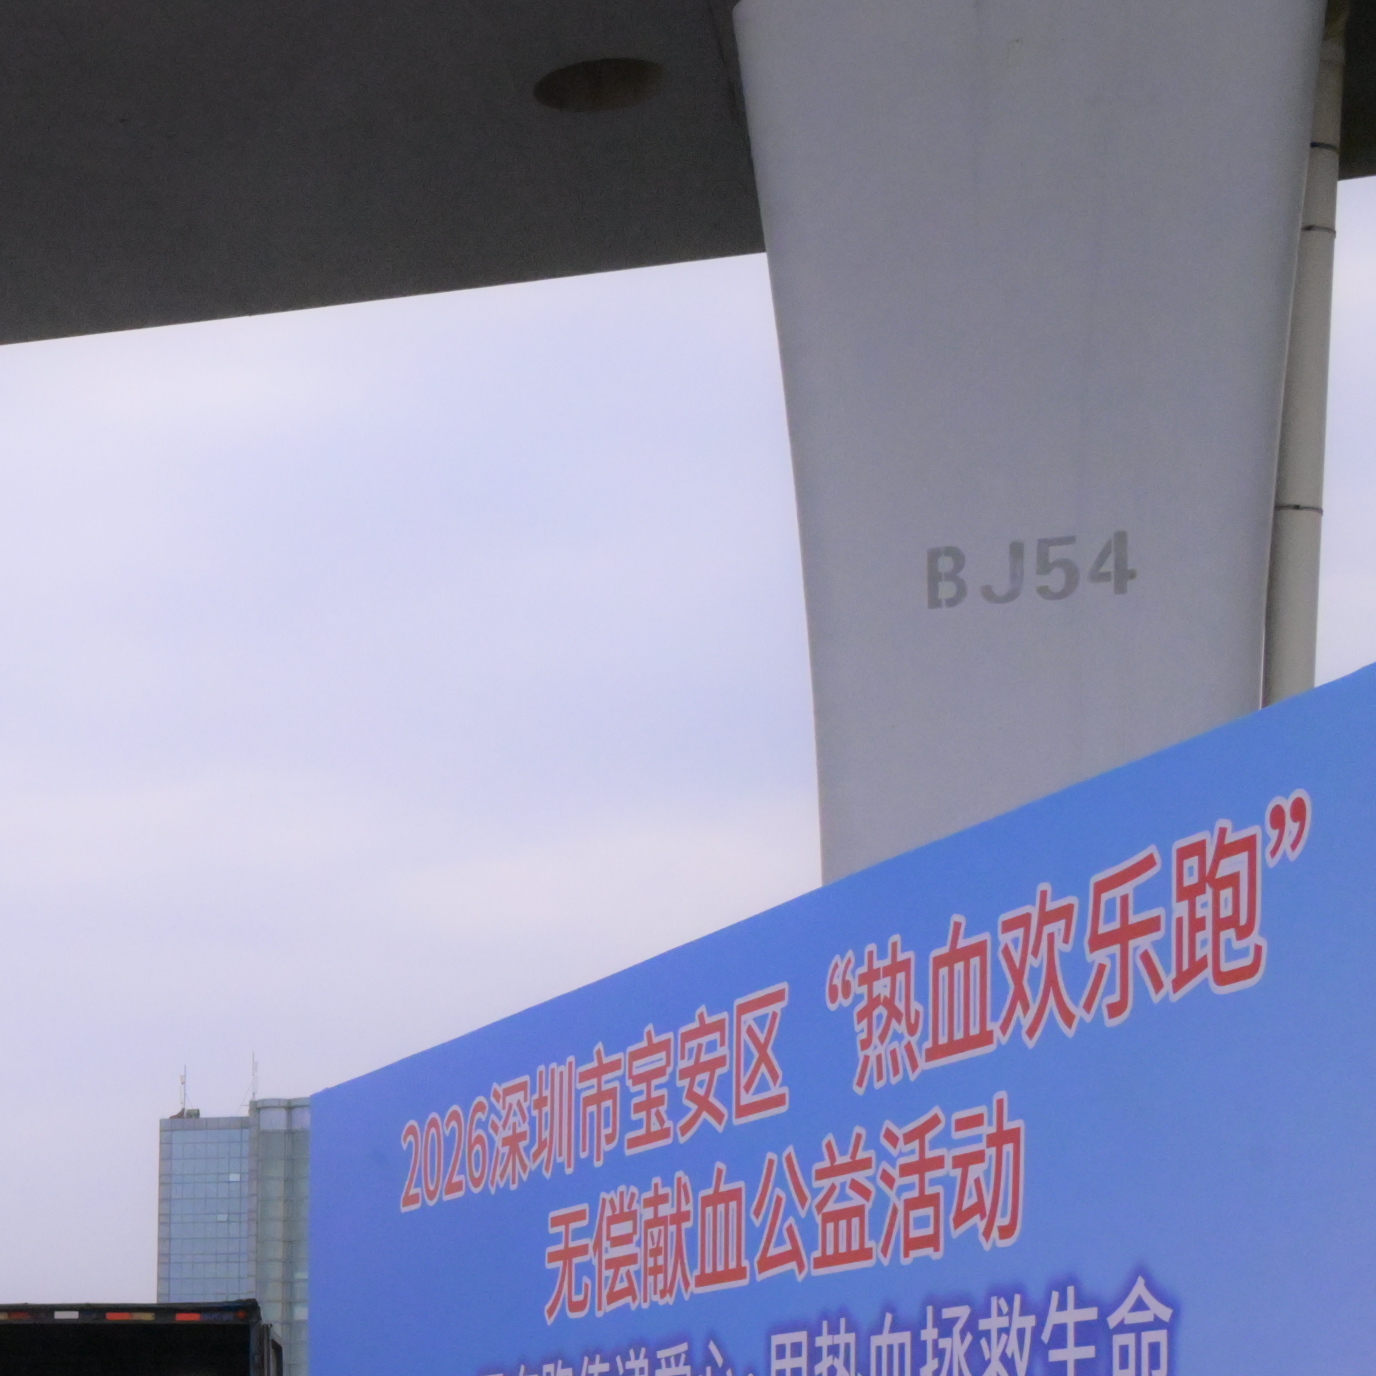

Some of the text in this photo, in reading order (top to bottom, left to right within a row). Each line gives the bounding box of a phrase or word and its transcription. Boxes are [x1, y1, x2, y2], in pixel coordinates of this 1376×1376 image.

[926, 530, 1138, 609] BJ54
[399, 983, 789, 1213] 2026深圳市宝安区
[544, 1092, 1025, 1326] 无偿献血公益活动
